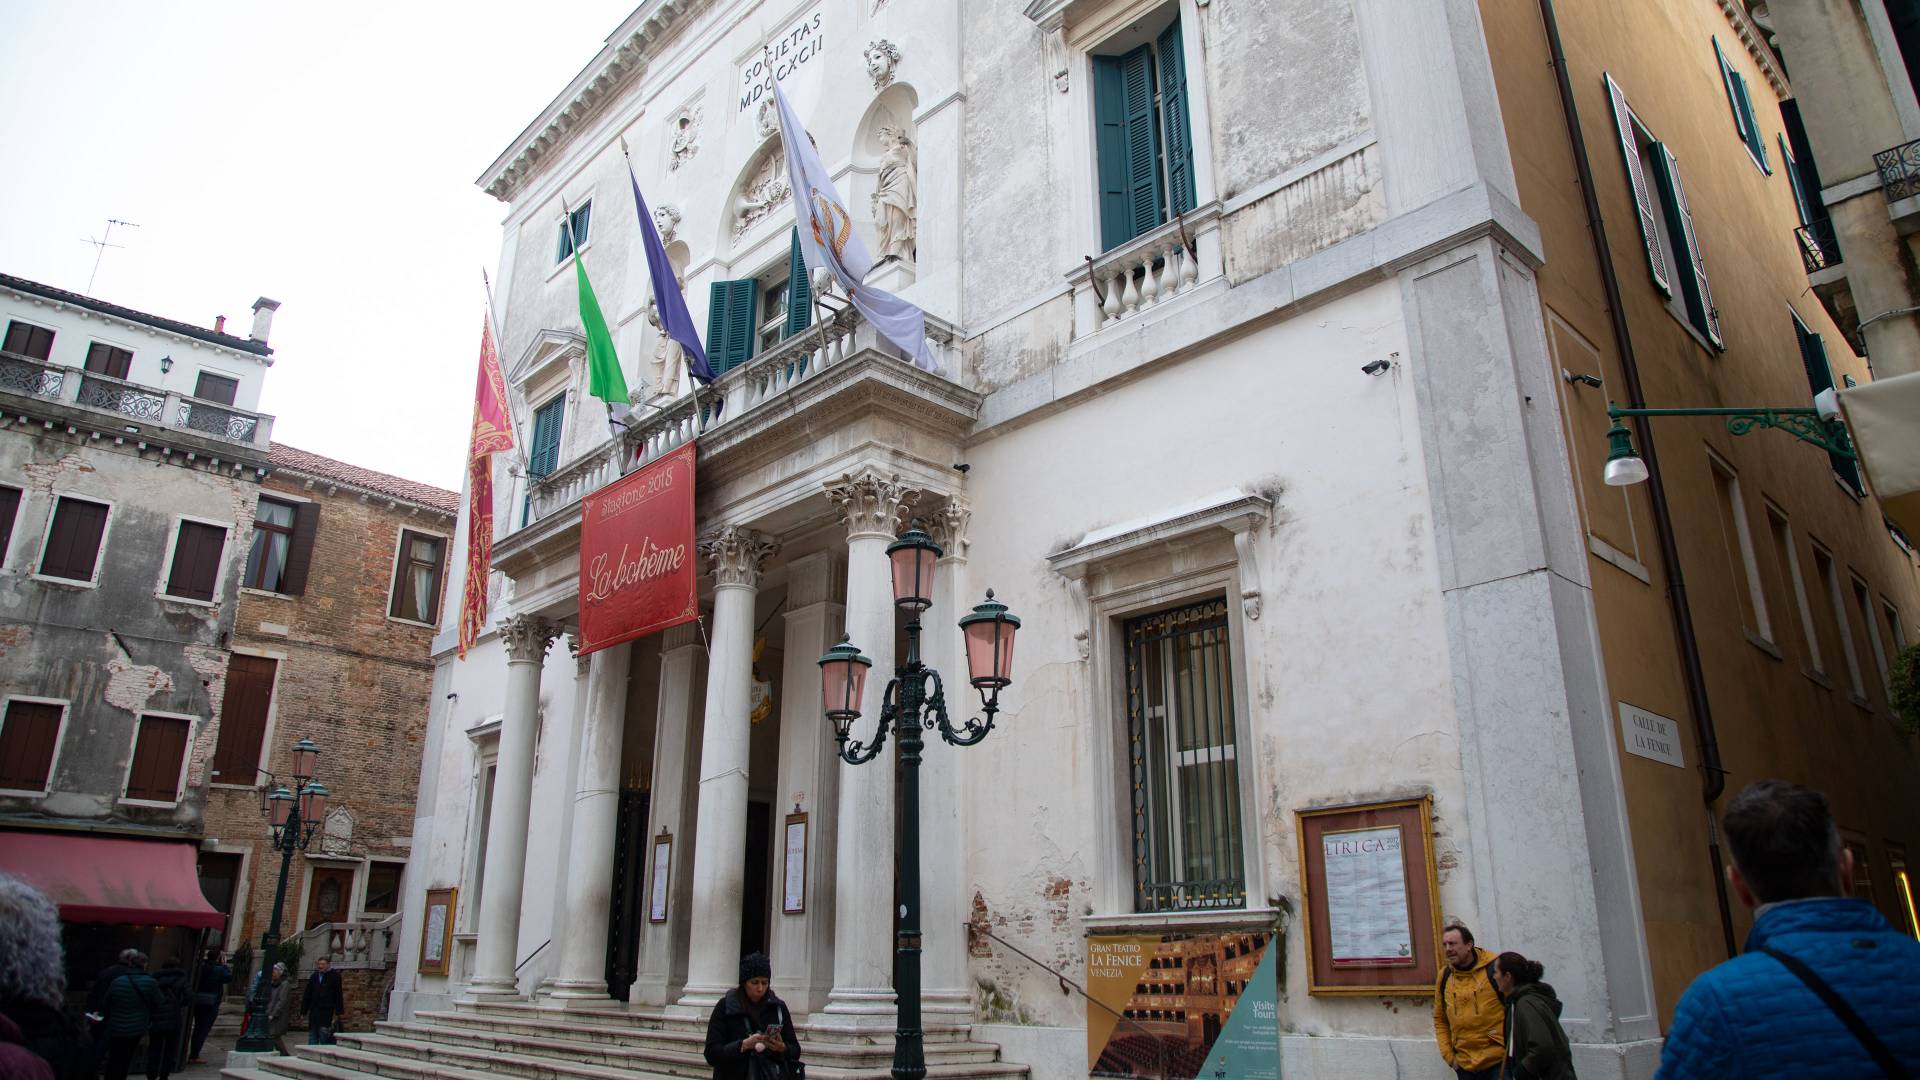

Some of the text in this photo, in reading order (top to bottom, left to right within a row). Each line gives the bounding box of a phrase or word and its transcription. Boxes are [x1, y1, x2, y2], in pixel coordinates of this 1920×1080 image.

[744, 13, 821, 85] SOCIETAS
[740, 34, 823, 113] MDCCXCII
[601, 465, 674, 517] Stagione 2018
[586, 536, 686, 600] La bohème
[1633, 714, 1656, 733] CALLE
[1635, 734, 1673, 757] LA FENICE
[1325, 839, 1385, 856] LIRICA
[1090, 943, 1141, 953] GRAN TEATRO
[1091, 953, 1143, 967] LA FENICE
[1090, 968, 1123, 977] VENEZIA
[1252, 1000, 1275, 1010] Visite
[1252, 1009, 1276, 1019] Tours
